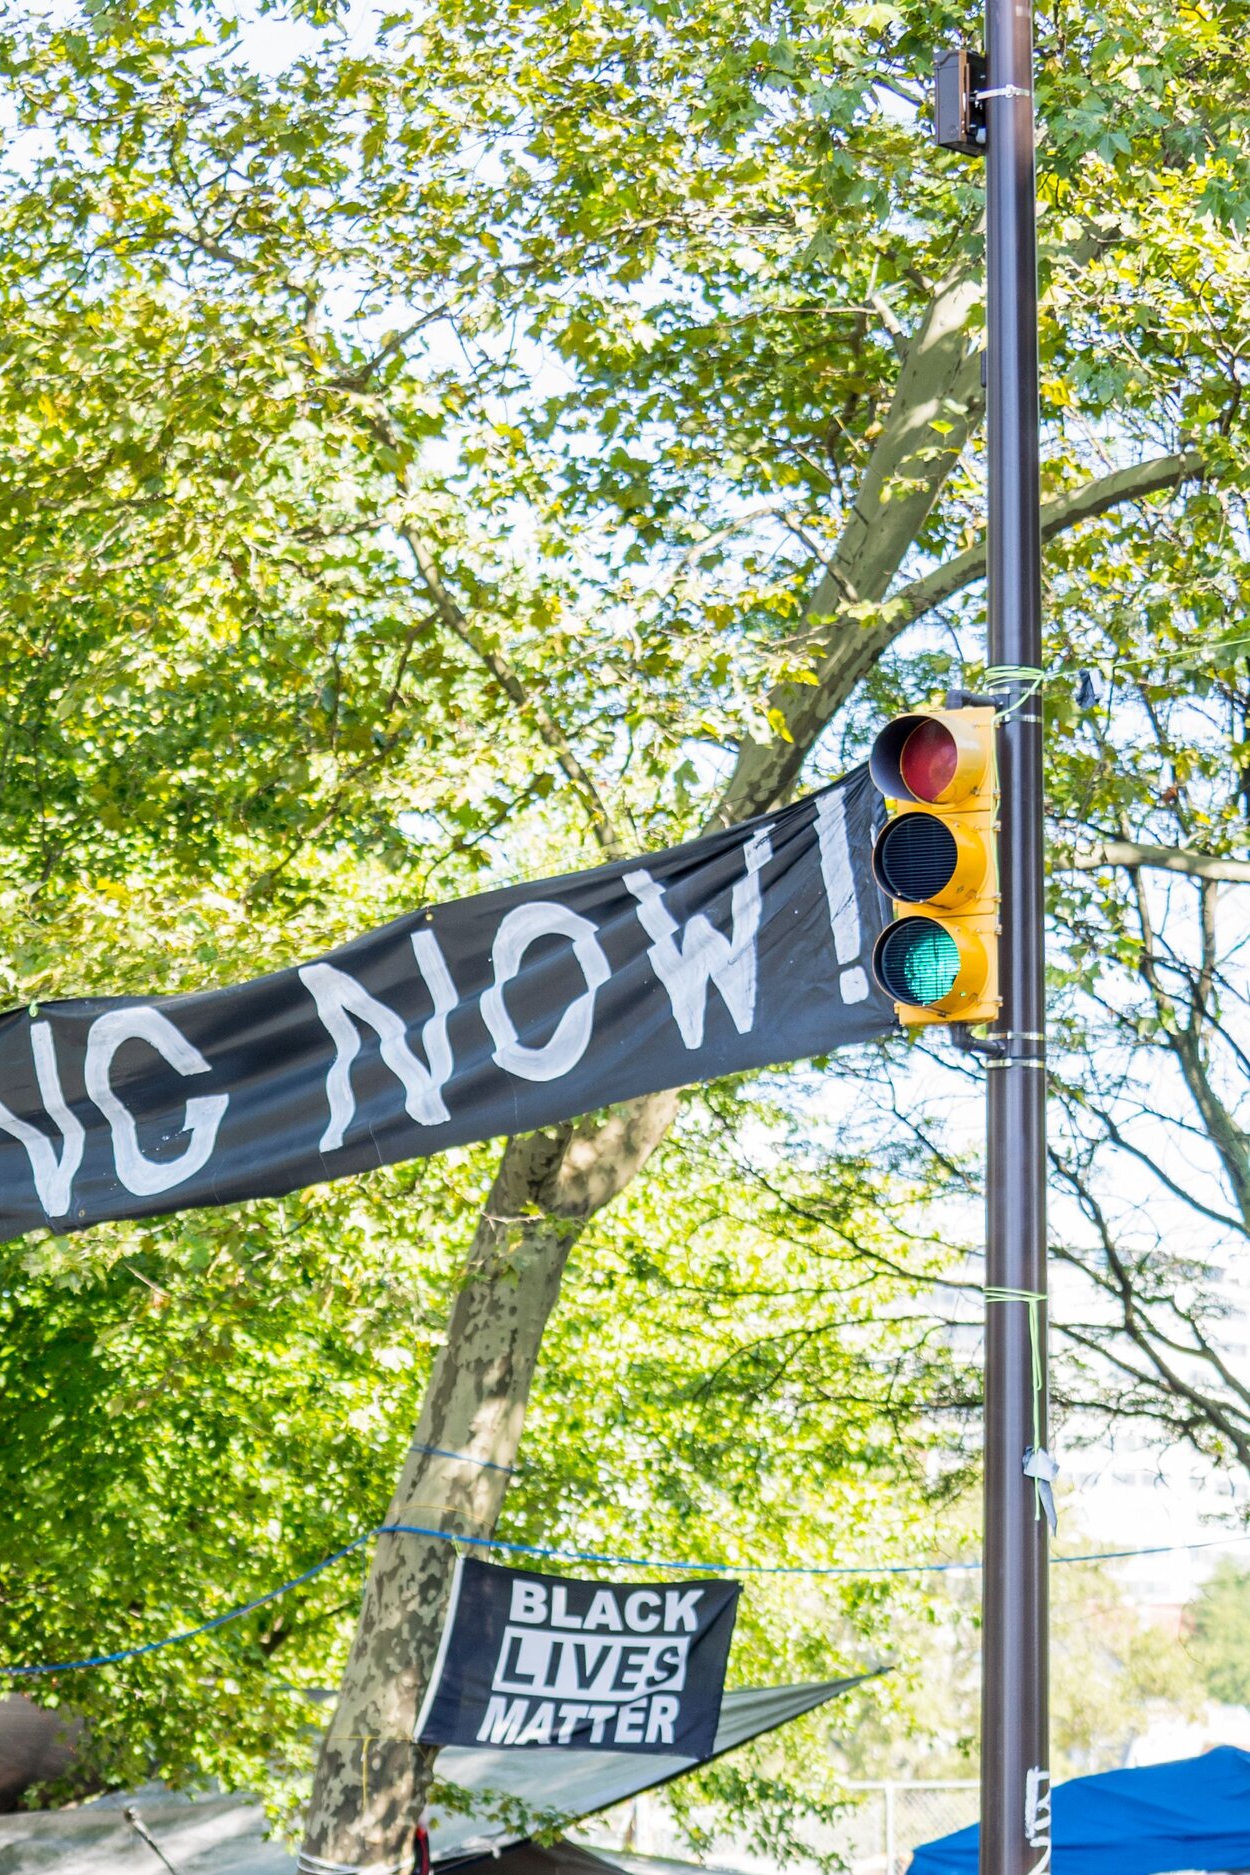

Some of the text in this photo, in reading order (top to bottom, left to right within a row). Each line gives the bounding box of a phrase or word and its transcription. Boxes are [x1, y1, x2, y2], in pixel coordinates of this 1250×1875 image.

[297, 787, 869, 1152] NOW!
[509, 1579, 705, 1632] BLACK
[500, 1636, 682, 1692] LIVES
[476, 1695, 680, 1746] MATTER
